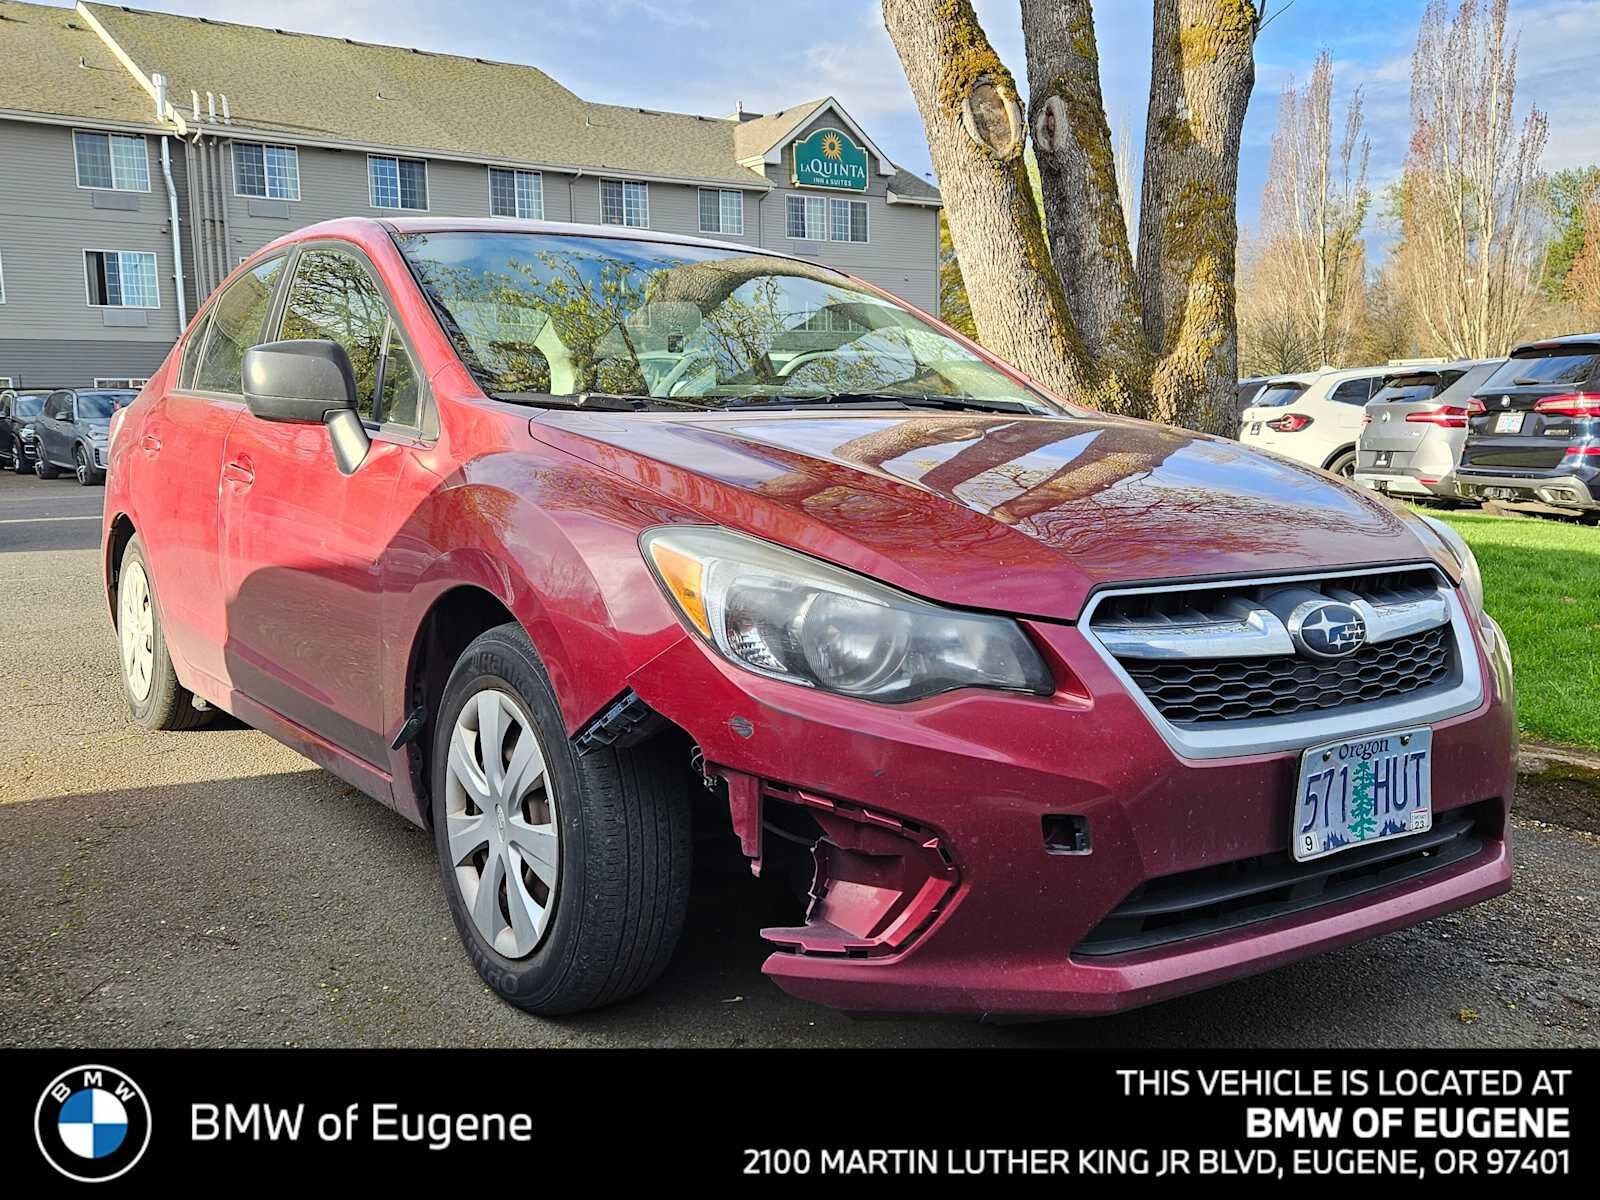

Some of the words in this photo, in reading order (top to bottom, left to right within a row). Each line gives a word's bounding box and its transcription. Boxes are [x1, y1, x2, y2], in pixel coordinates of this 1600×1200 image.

[800, 163, 811, 173] LA
[811, 158, 865, 179] QUINTA
[830, 179, 852, 187] SUITES
[1338, 739, 1390, 761] Oregon
[1302, 766, 1349, 832] 571
[1373, 752, 1427, 817] HUT
[1305, 836, 1313, 851] 9
